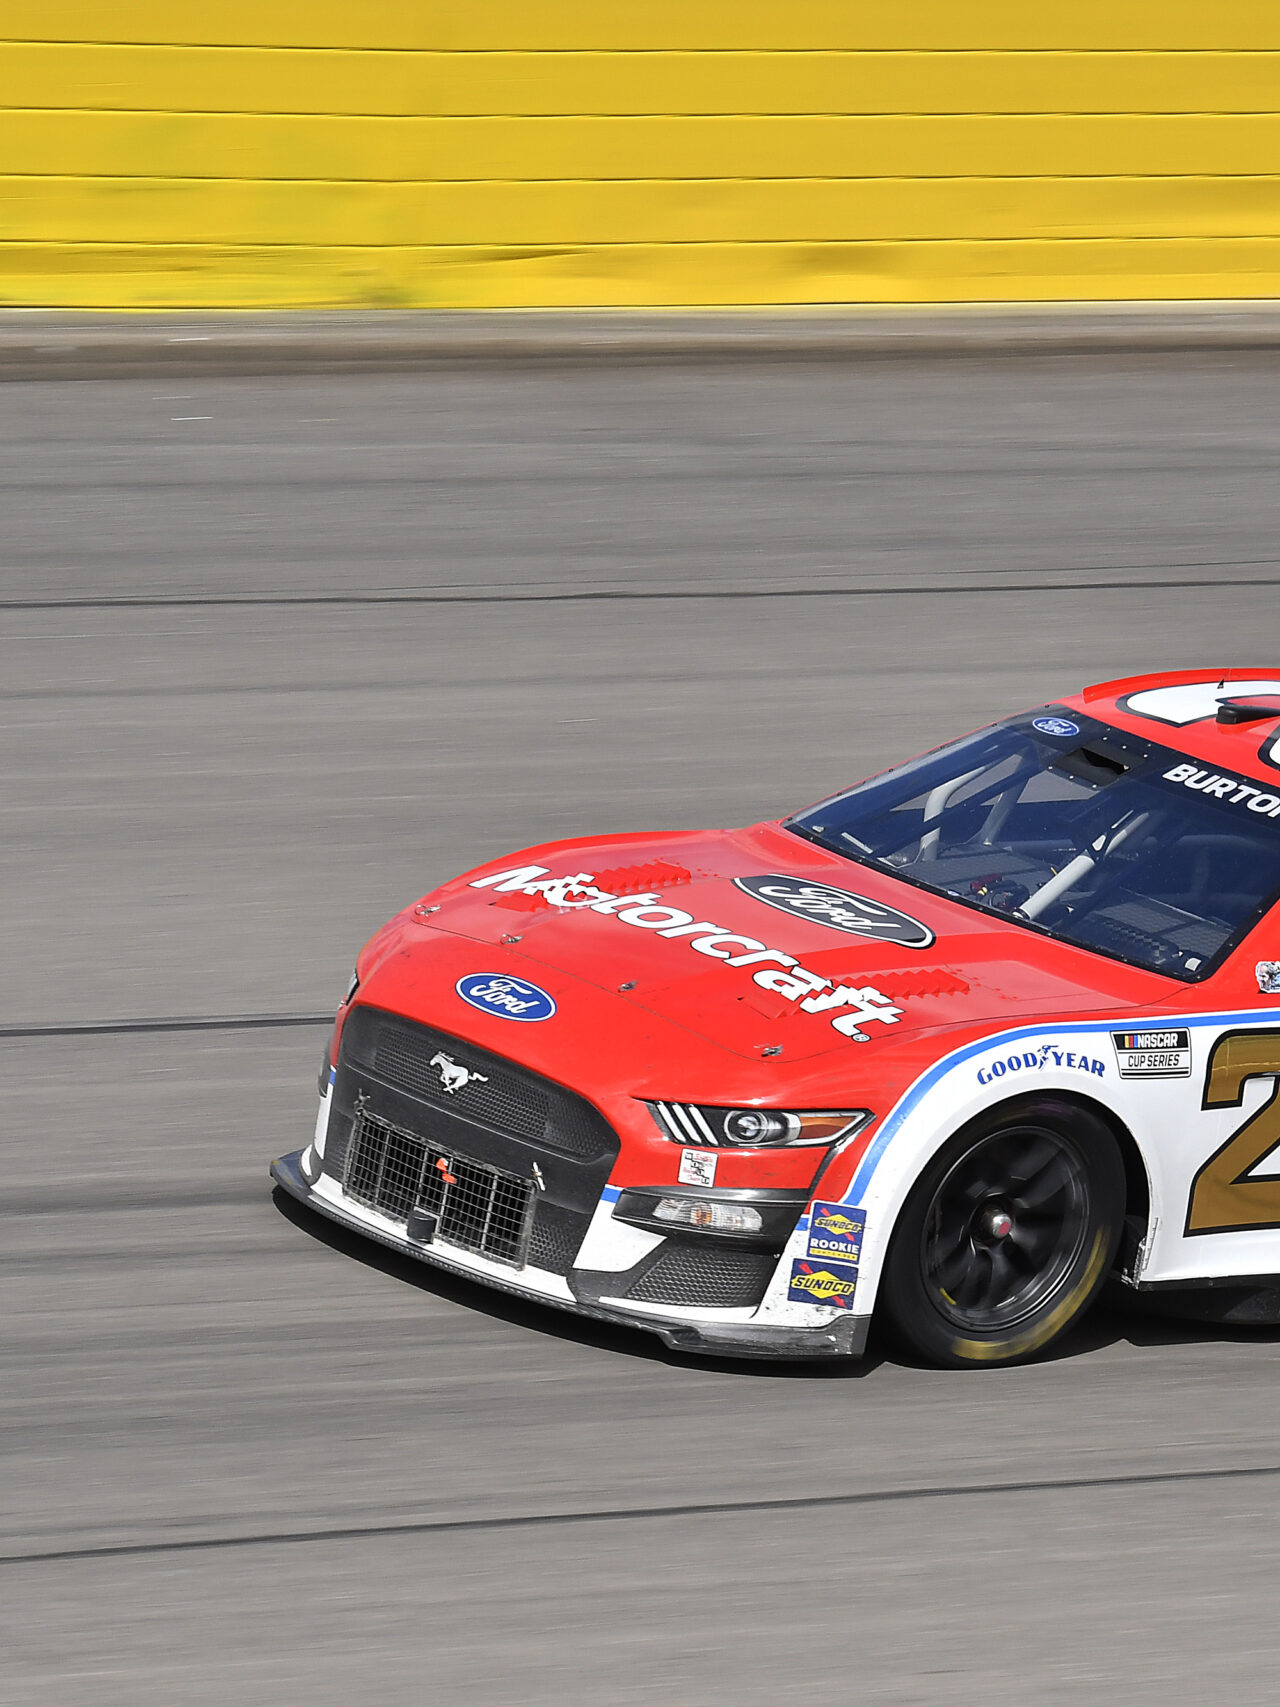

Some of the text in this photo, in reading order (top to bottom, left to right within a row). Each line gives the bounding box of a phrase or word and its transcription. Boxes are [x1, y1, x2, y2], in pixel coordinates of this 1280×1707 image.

[1039, 718, 1076, 735] Ford
[758, 886, 902, 932] Ford
[468, 864, 906, 1037] Motorcraft
[469, 976, 535, 1016] Ford
[1137, 1032, 1179, 1048] NASCAR
[1128, 1053, 1180, 1068] CUP SERIES
[816, 1217, 862, 1233] SUNOCO
[810, 1237, 860, 1255] ROOKIE
[793, 1277, 855, 1295] SUNOCO
